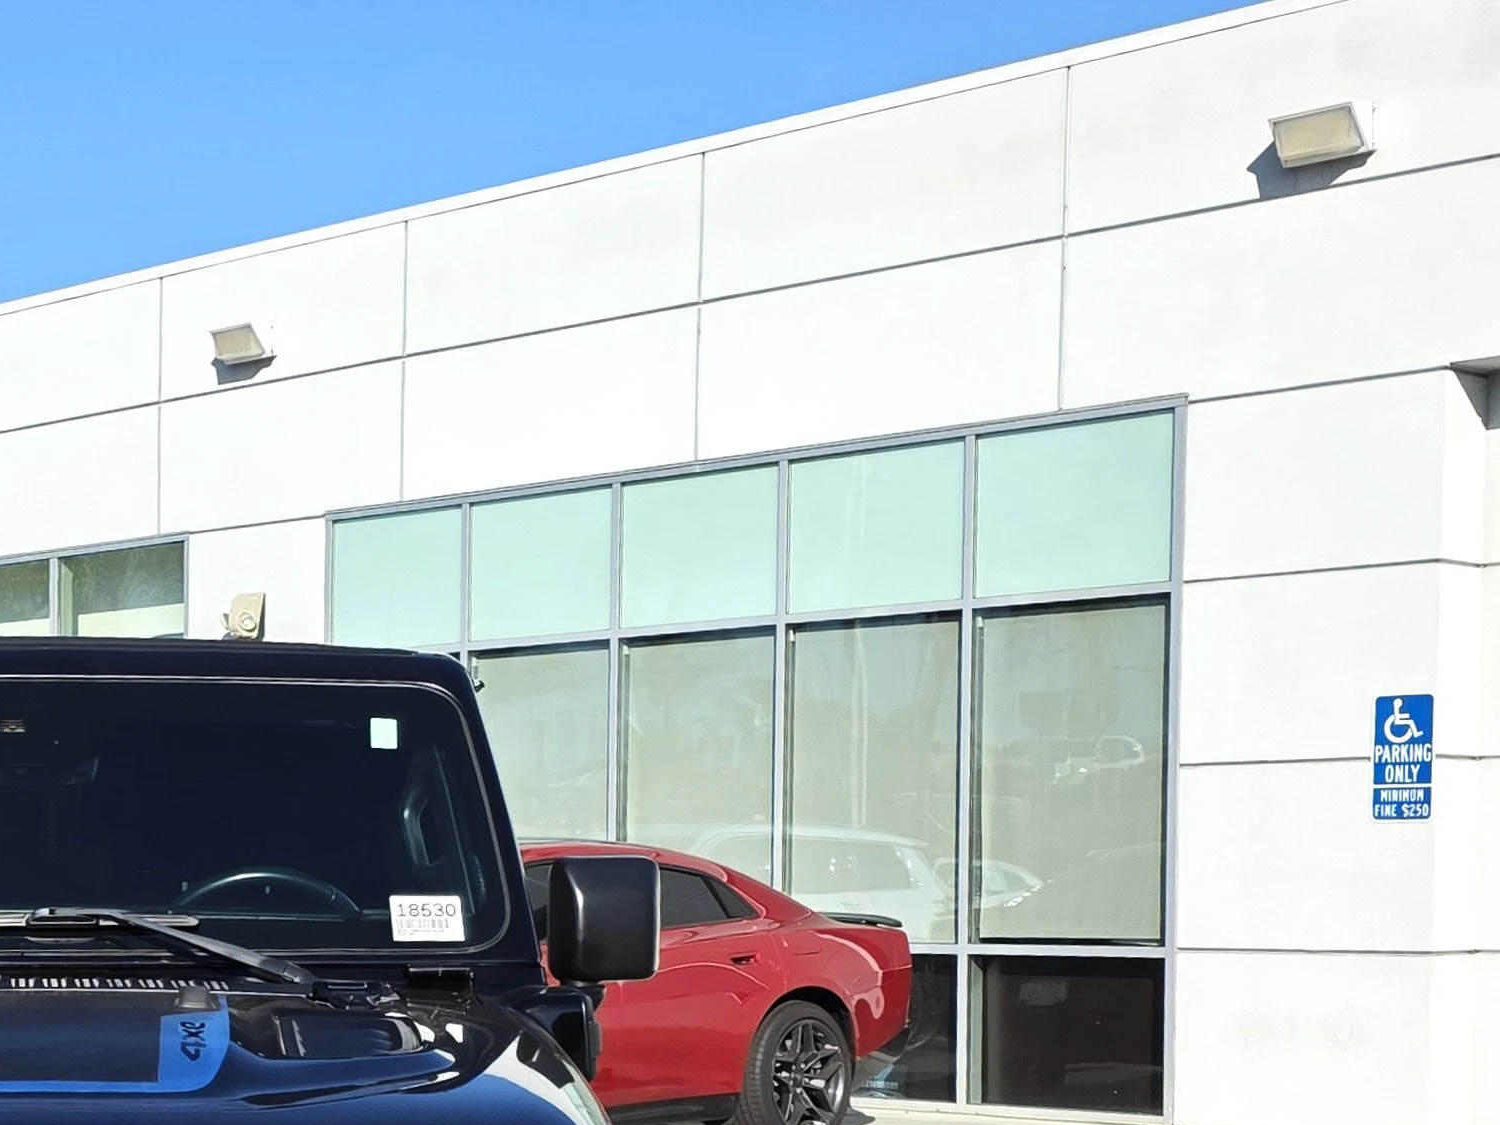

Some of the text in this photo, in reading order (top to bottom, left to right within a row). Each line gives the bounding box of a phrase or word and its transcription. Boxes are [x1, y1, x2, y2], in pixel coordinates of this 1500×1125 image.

[1374, 743, 1432, 763] PARKING
[1385, 764, 1421, 783] ONLY
[1380, 789, 1424, 802] MINIMUM
[1374, 803, 1429, 817] FINE $250
[397, 903, 456, 917] 18530
[180, 1021, 207, 1061] 4xe
